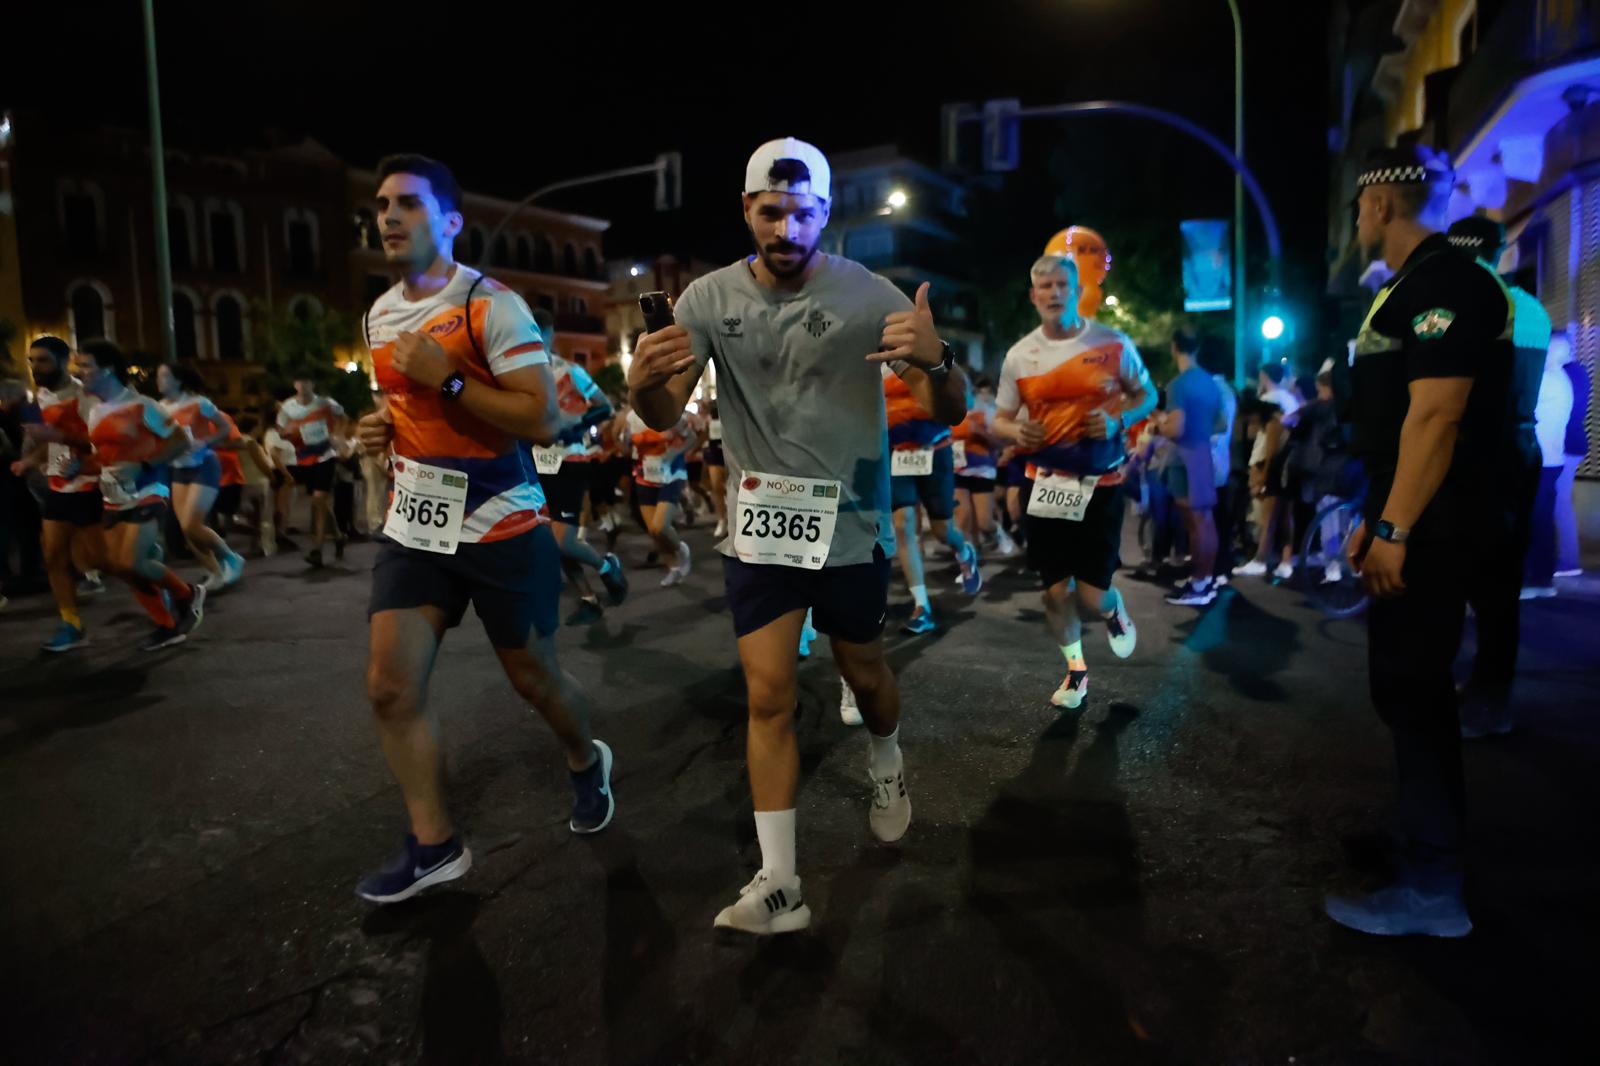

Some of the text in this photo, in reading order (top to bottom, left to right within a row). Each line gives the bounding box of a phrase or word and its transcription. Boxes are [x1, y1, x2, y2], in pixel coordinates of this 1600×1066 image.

[396, 490, 450, 529] 24565
[1037, 488, 1083, 507] 20058
[741, 508, 821, 543] 23365
